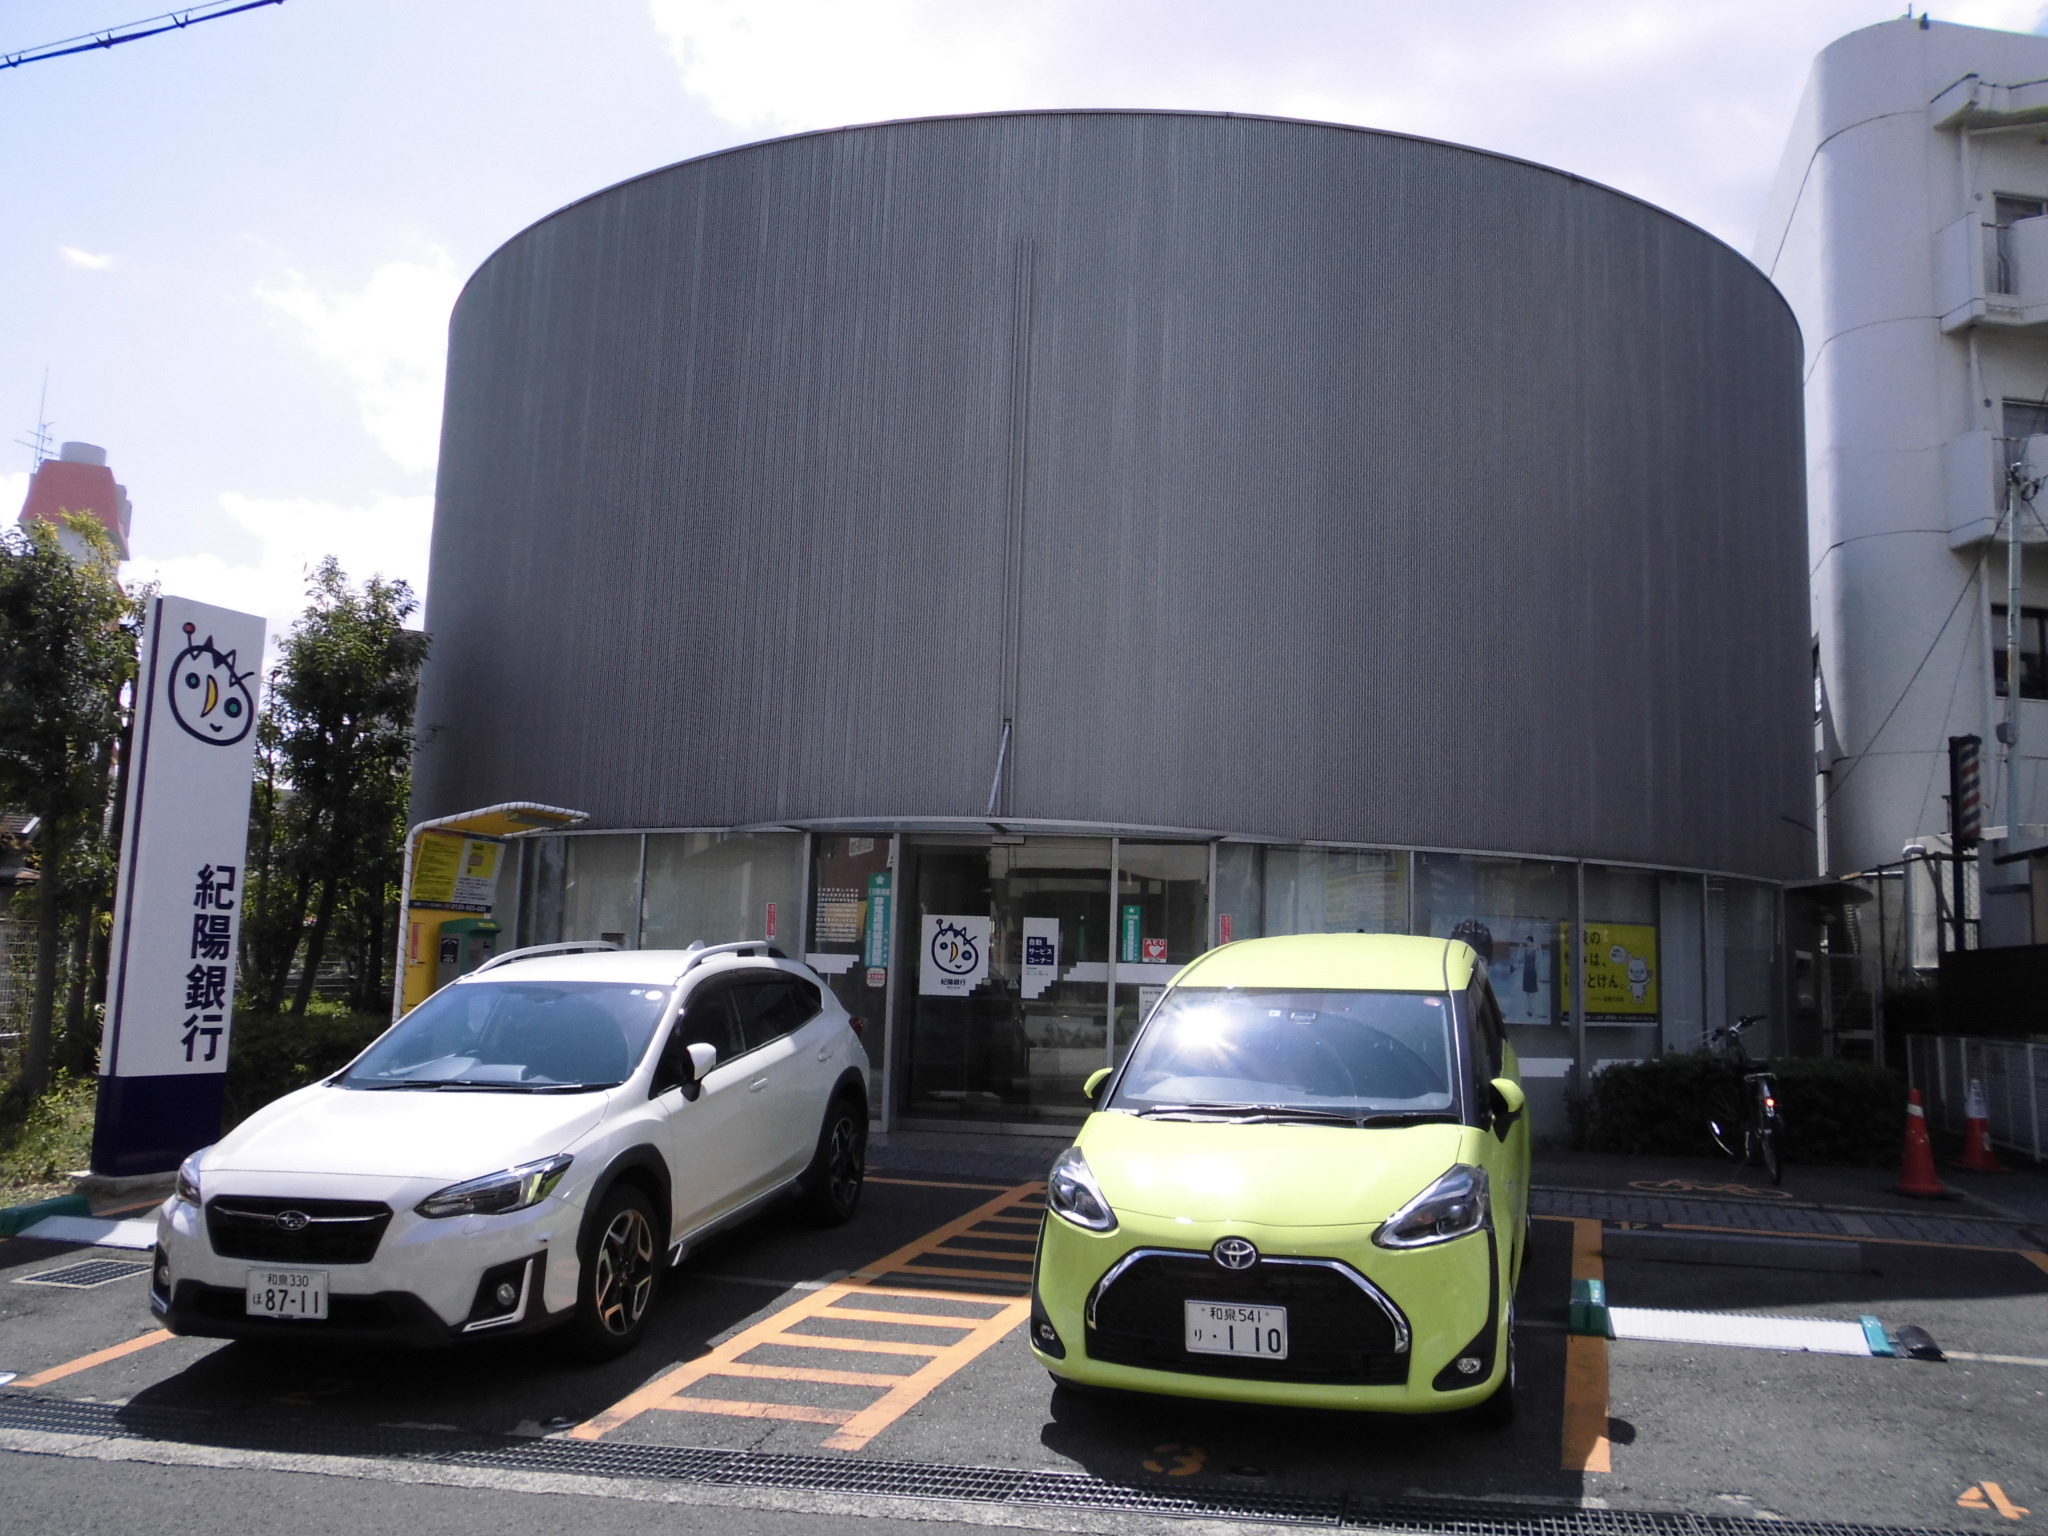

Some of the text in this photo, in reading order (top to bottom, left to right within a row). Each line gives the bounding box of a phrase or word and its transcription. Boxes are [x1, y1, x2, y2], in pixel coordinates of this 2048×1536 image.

[1029, 938, 1042, 946] 自動
[181, 863, 236, 1062] 紀陽銀行
[265, 1289, 318, 1314] 87-11
